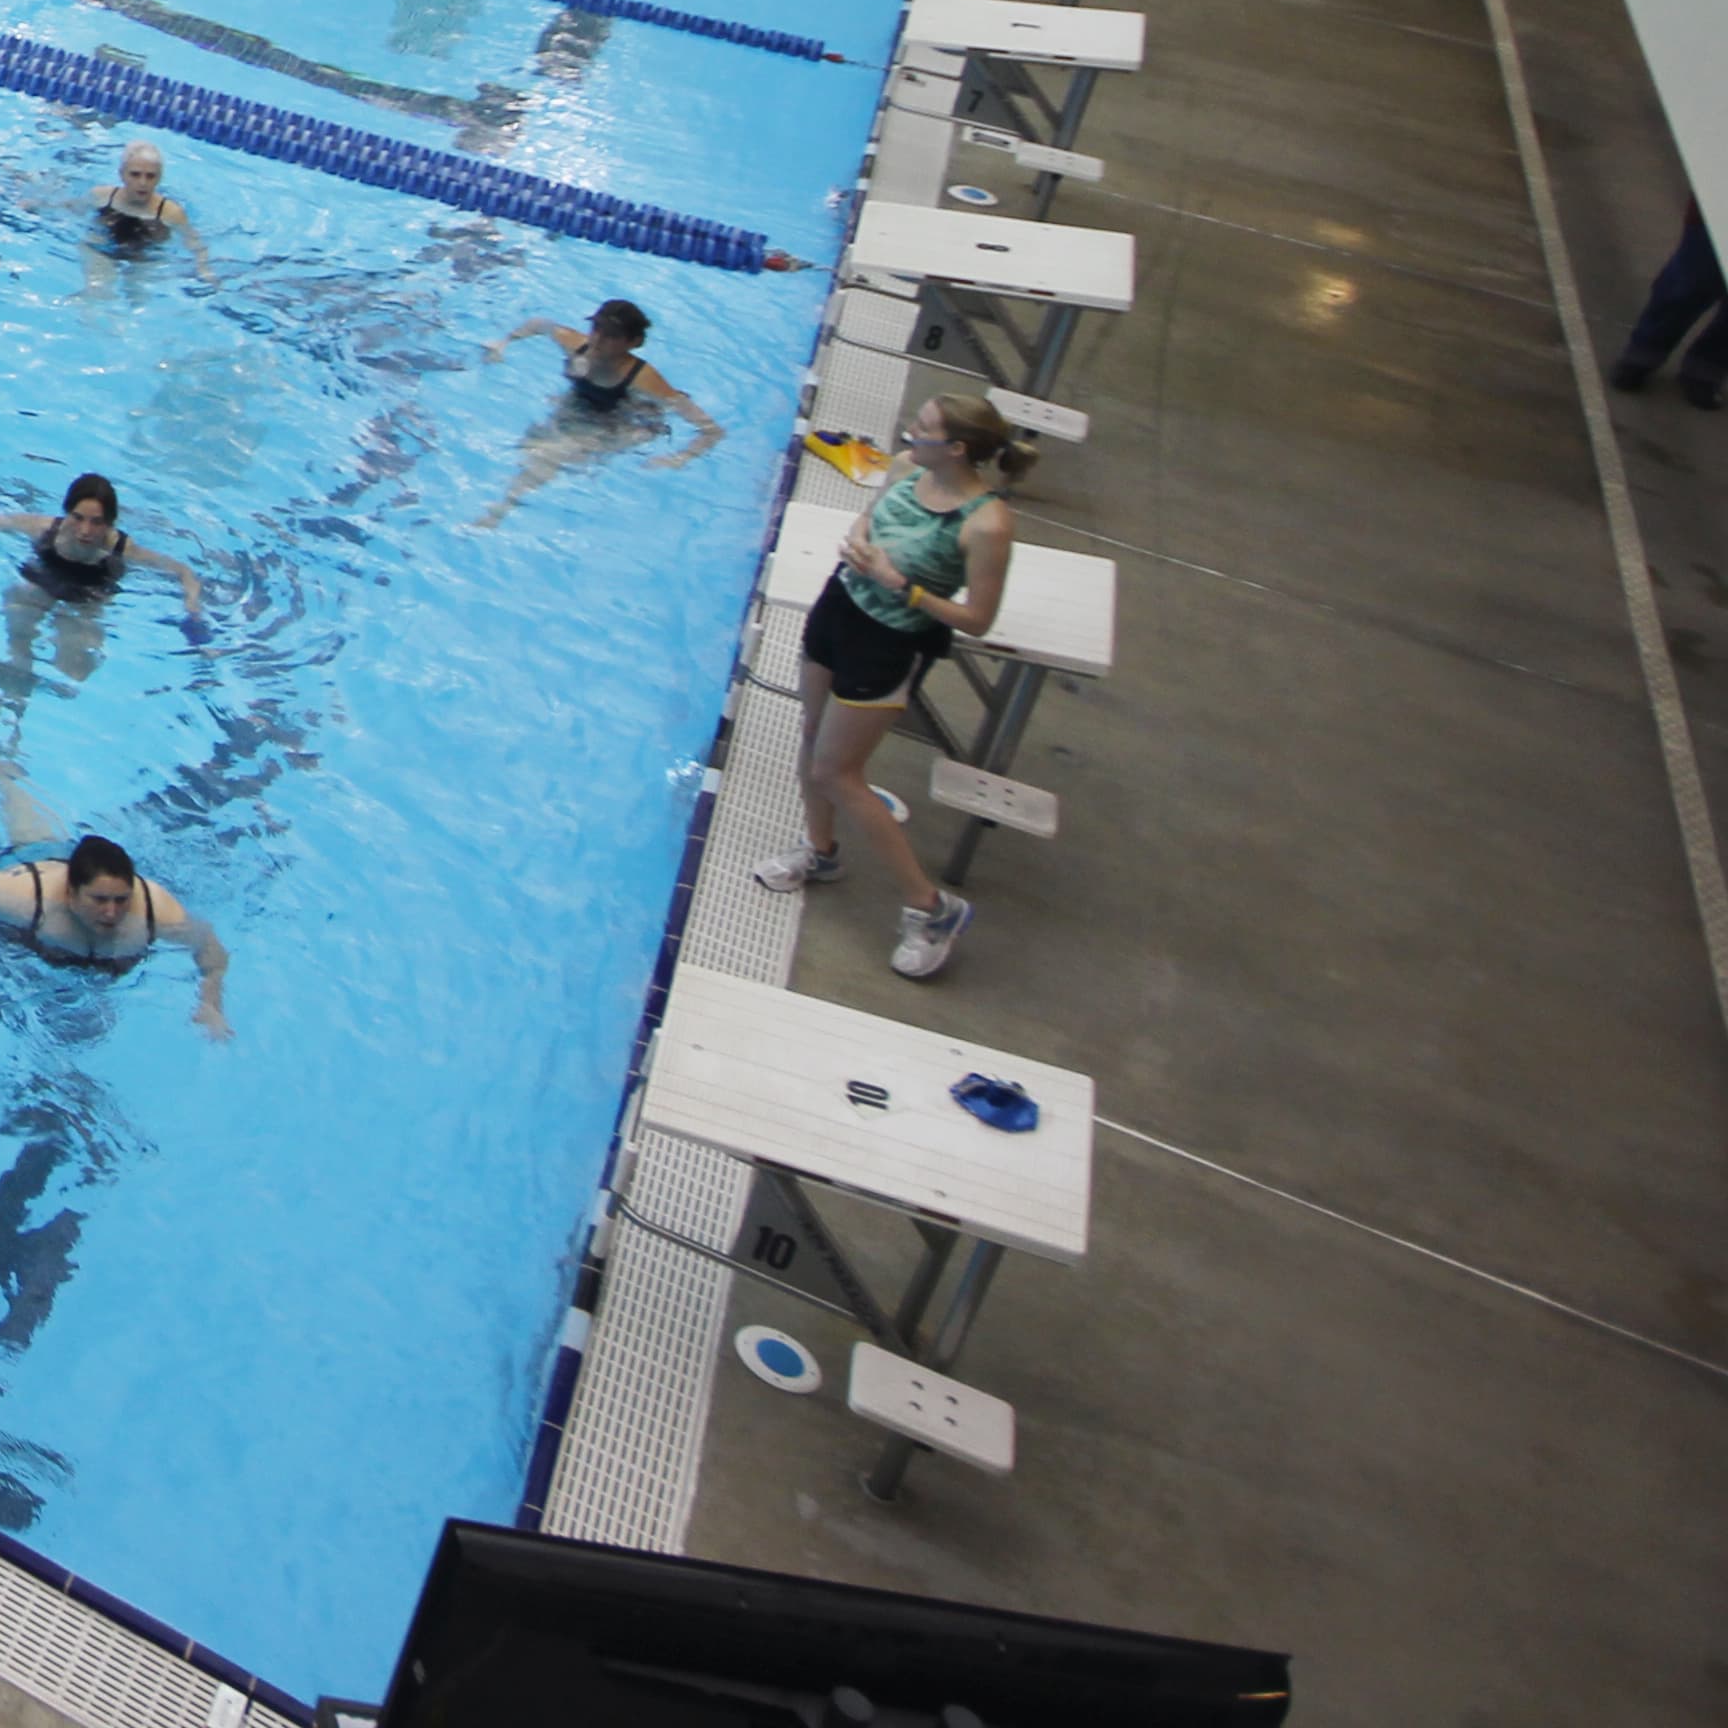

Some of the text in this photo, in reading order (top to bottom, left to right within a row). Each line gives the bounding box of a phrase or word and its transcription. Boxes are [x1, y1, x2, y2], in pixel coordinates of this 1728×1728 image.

[967, 89, 985, 114] 7
[924, 325, 944, 351] 8
[846, 1080, 890, 1111] 10
[751, 1225, 798, 1271] 10
